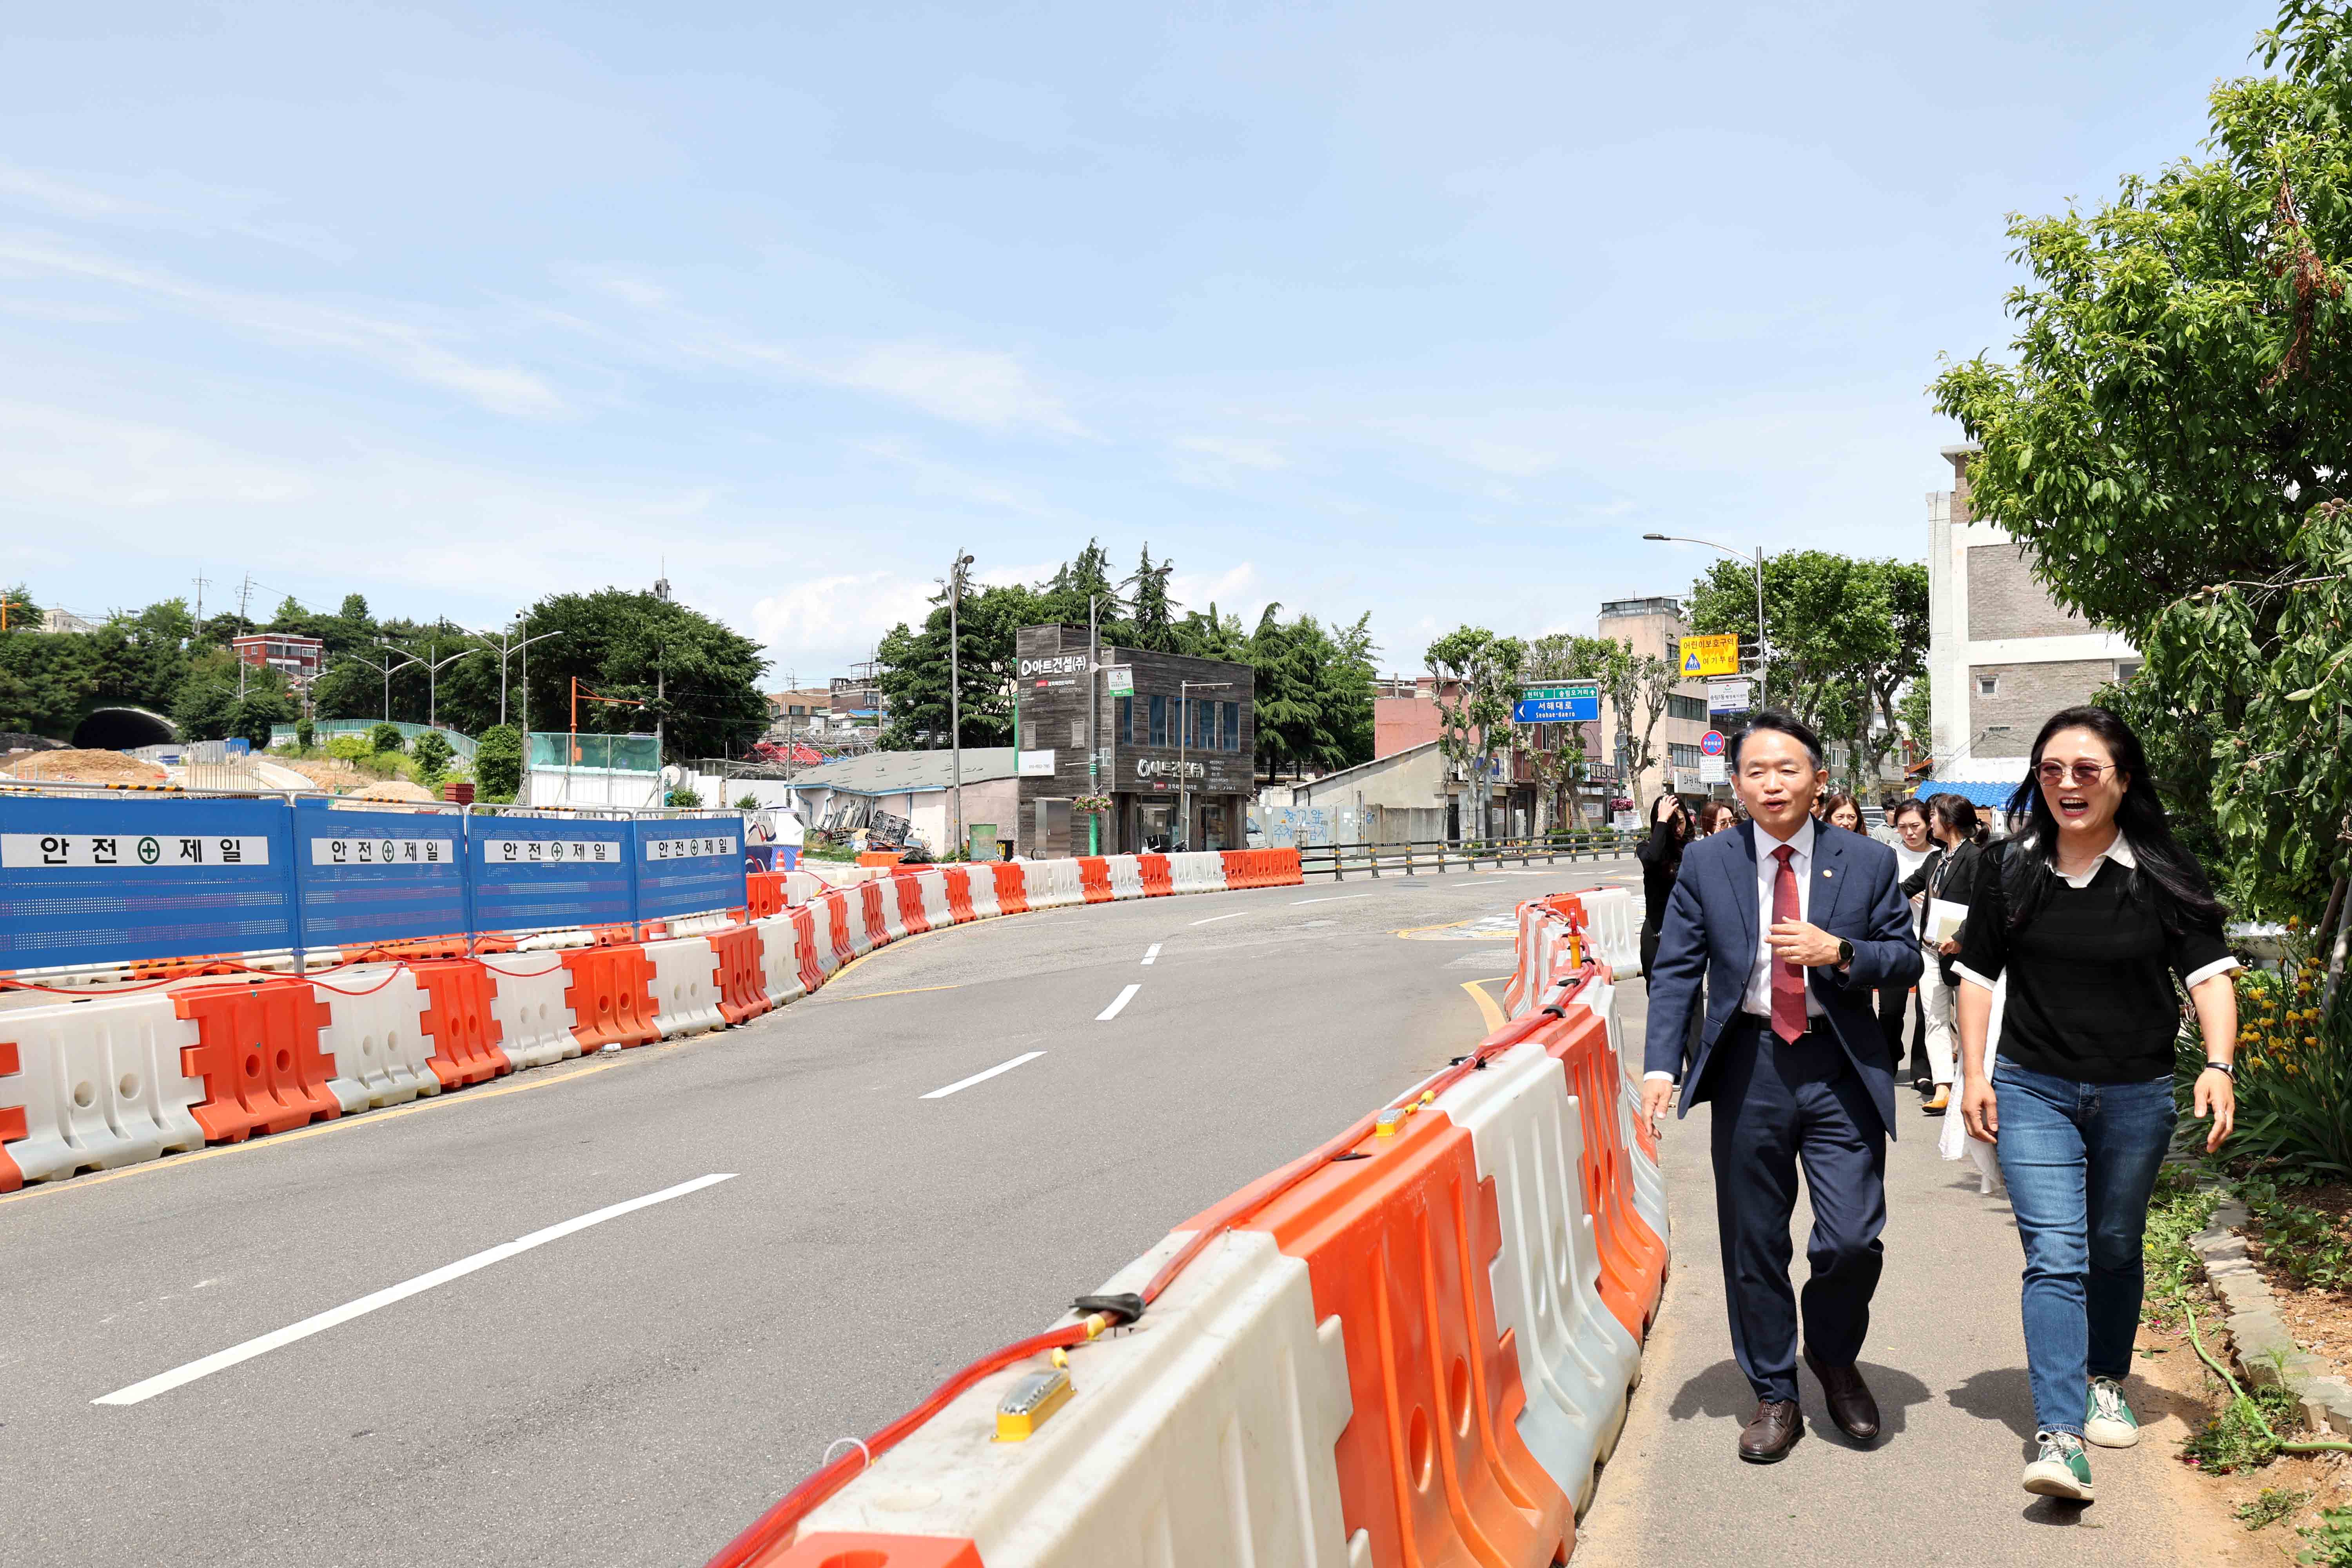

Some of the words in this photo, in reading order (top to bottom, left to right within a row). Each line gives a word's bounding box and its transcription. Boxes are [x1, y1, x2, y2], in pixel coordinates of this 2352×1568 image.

[1684, 638, 1734, 649] 어린이보호구역
[1032, 655, 1086, 675] 아트건설(주)
[1559, 689, 1588, 697] 송림오거리
[1538, 701, 1573, 710] 서해대로
[40, 837, 117, 864] 안전
[180, 838, 242, 863] 제일
[331, 841, 372, 862] 안전
[404, 842, 438, 861] 제일
[503, 842, 541, 861] 안전
[573, 843, 606, 860] 제일
[659, 841, 684, 858] 안전
[704, 839, 728, 855] 제일
